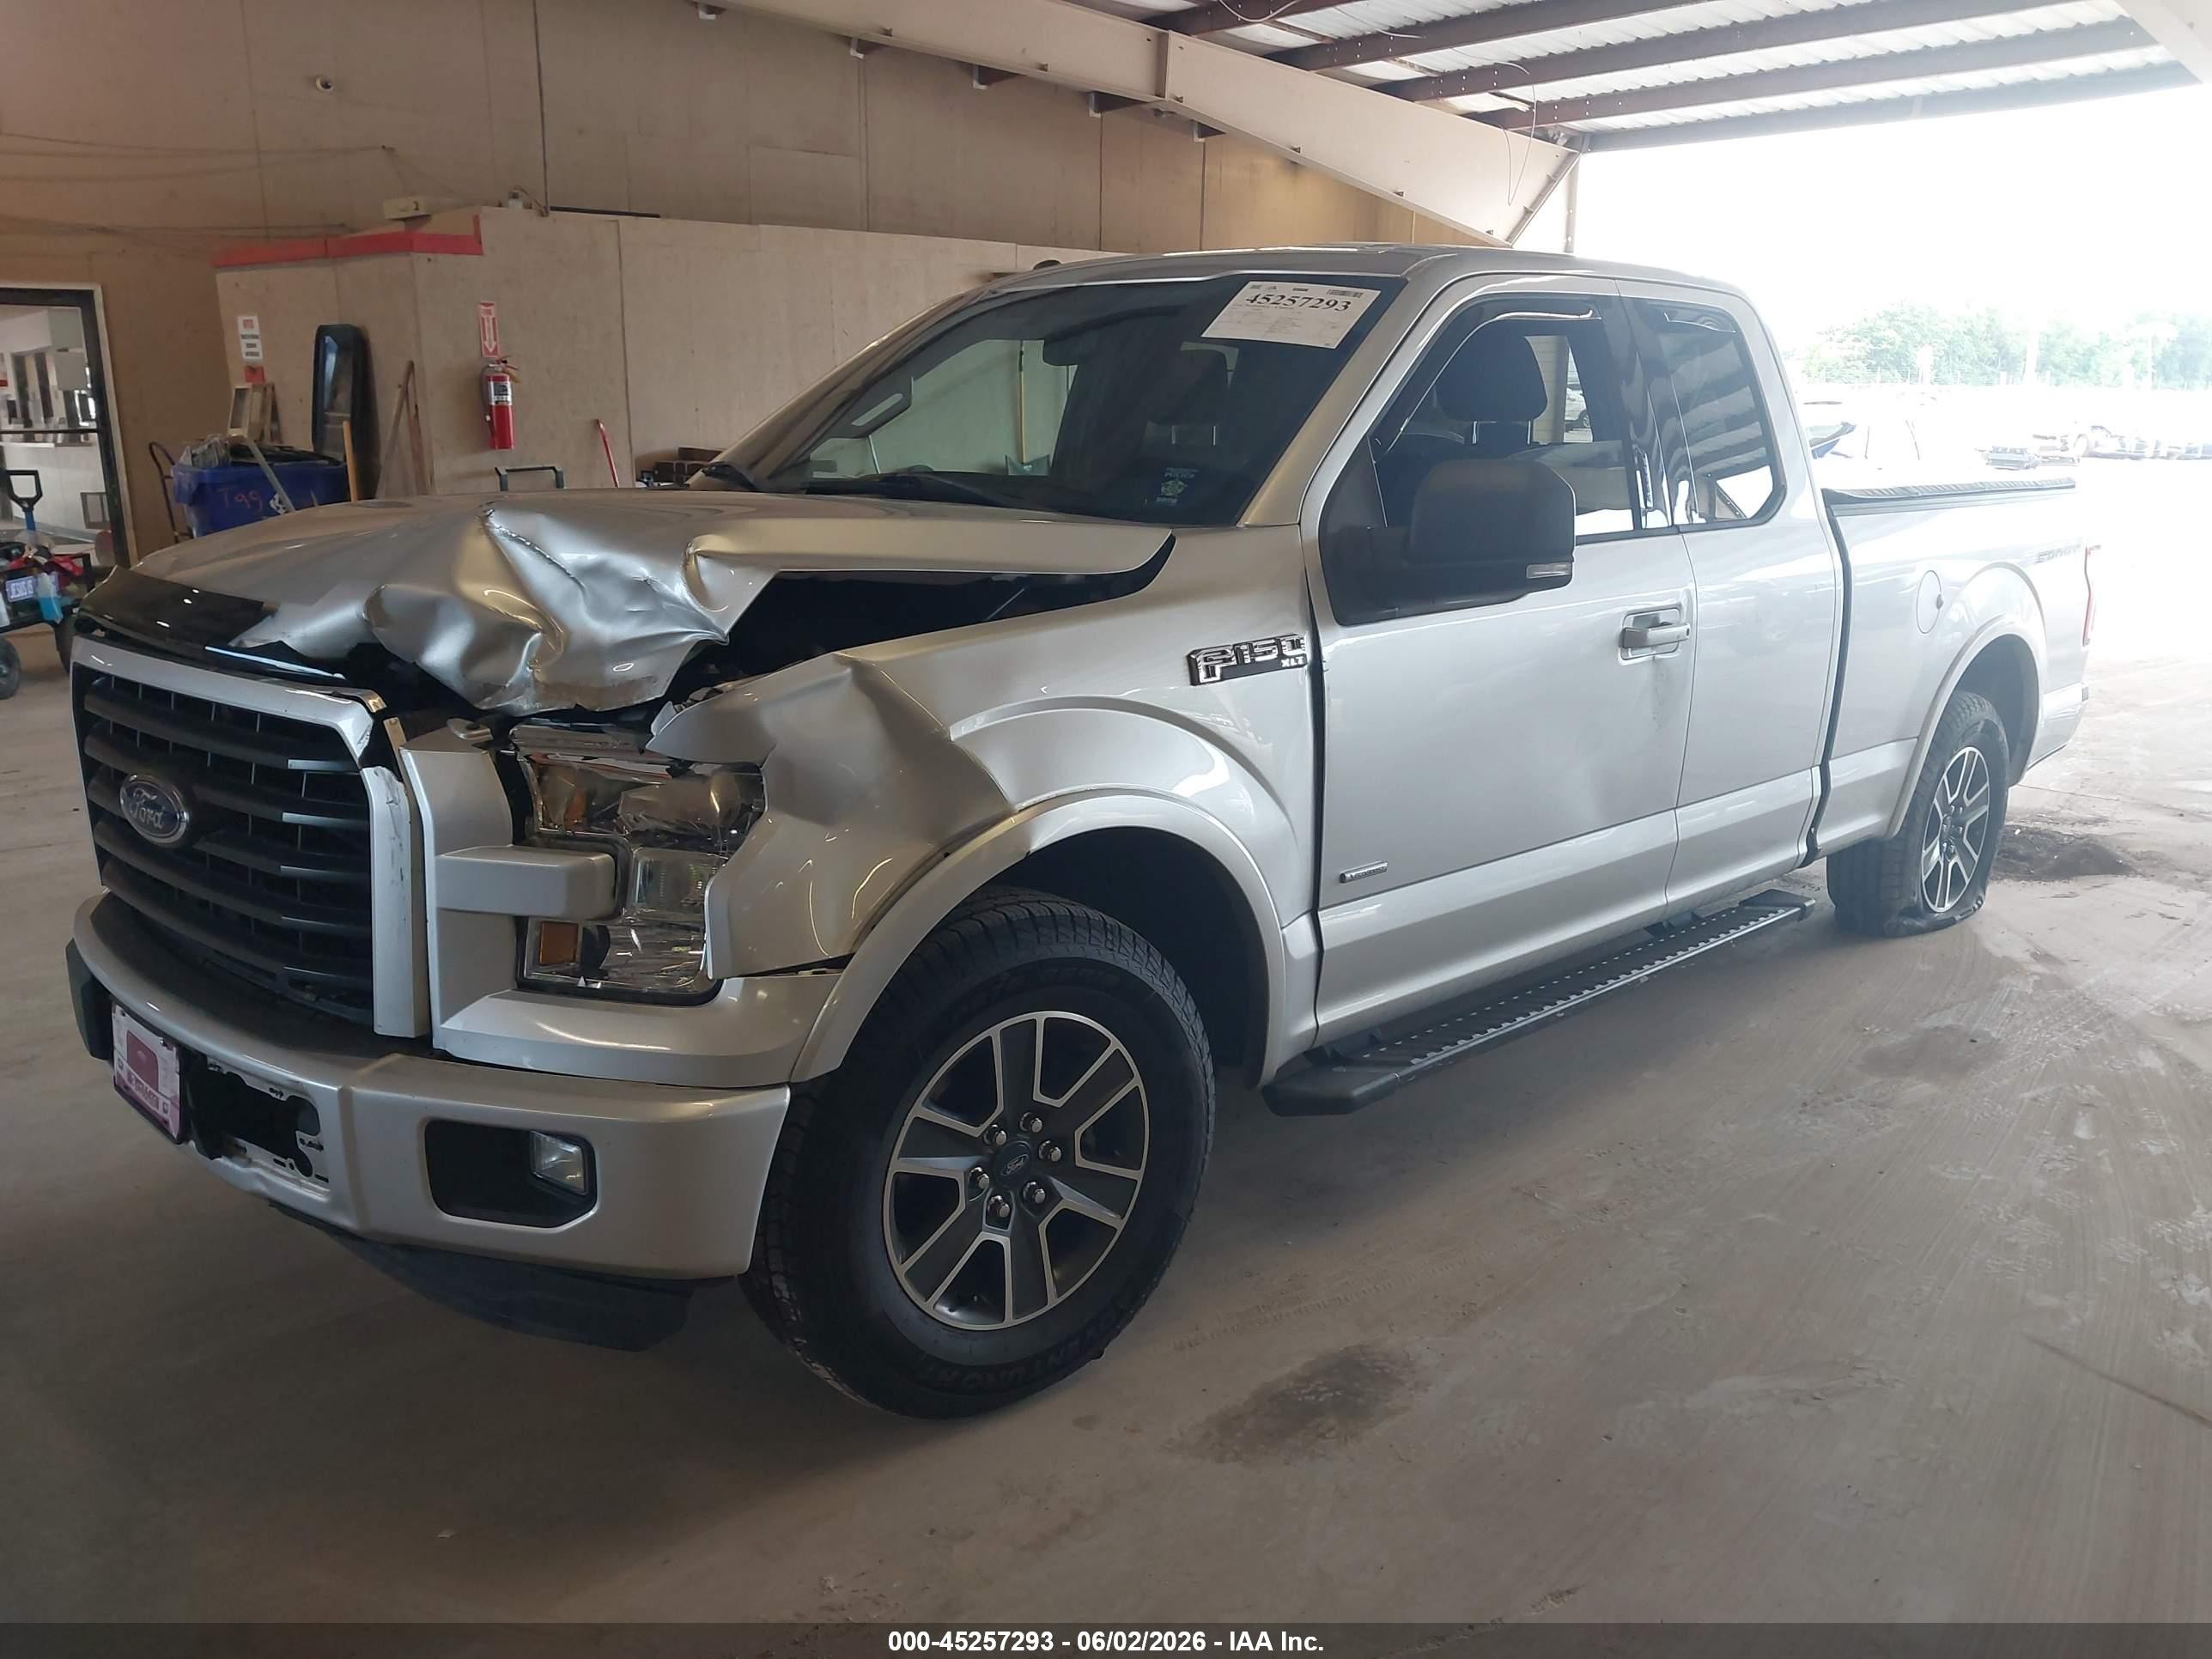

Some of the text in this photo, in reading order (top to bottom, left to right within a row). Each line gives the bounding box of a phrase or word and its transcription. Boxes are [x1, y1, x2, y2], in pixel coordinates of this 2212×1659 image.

[1245, 293, 1352, 312] 45257293
[1281, 655, 1304, 668] XLT
[130, 787, 164, 830] Ford
[1006, 1157, 1025, 1176] Ford
